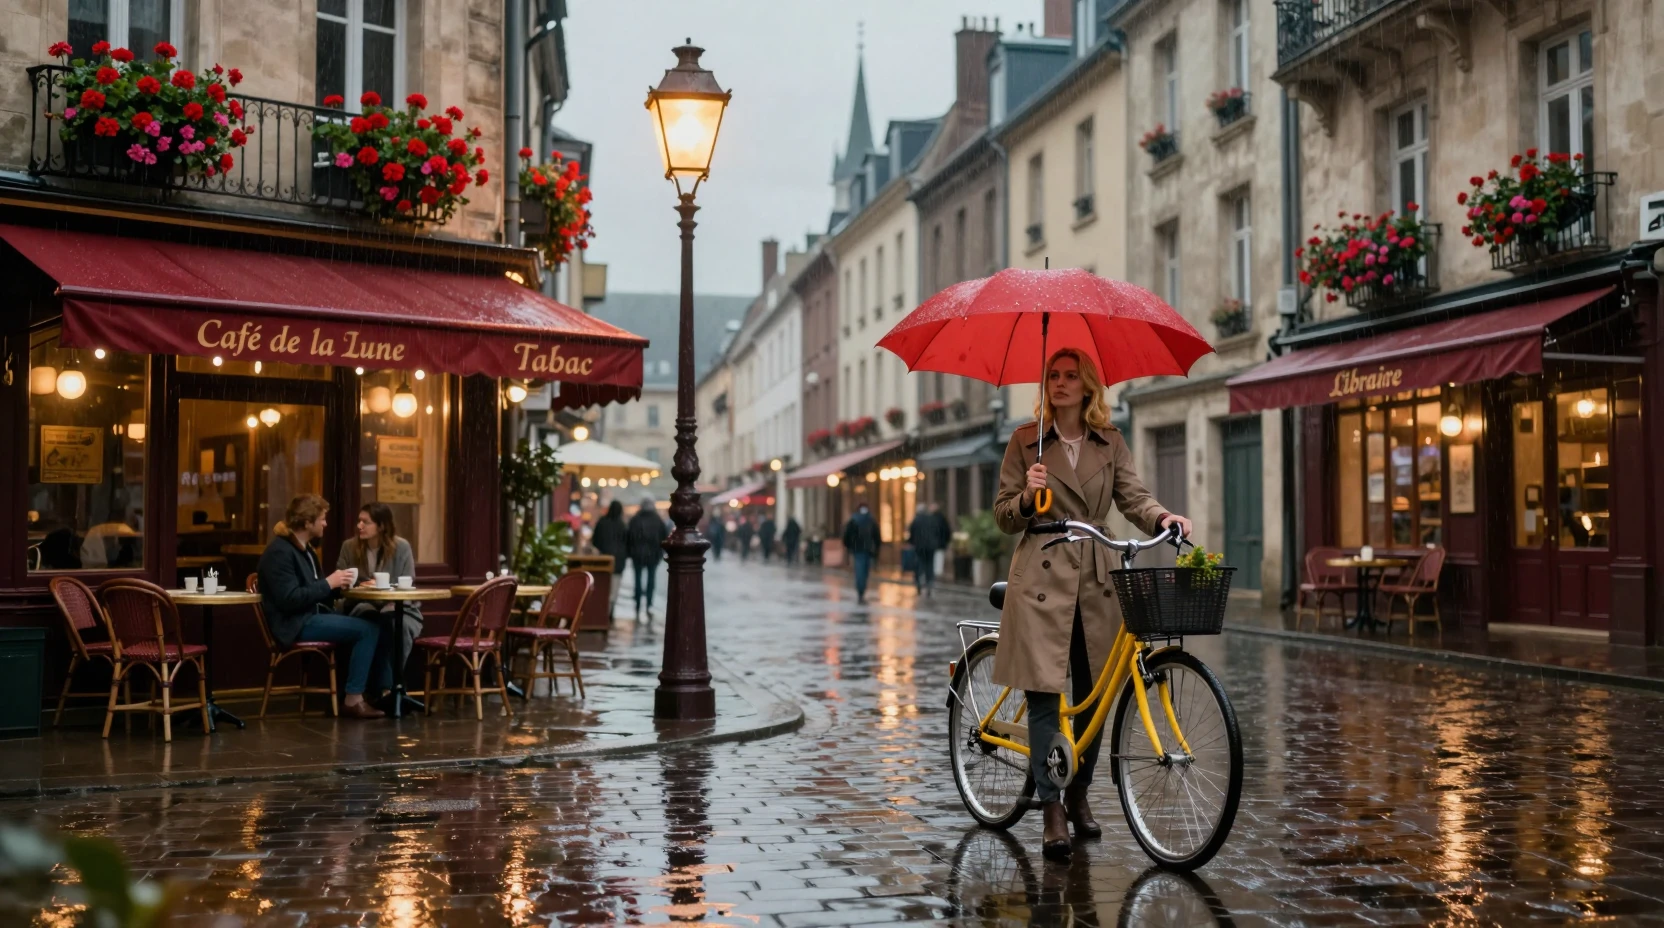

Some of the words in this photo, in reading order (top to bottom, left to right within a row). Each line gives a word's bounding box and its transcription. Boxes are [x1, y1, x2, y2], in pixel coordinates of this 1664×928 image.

[197, 319, 263, 357] Café
[269, 325, 301, 354] de
[310, 327, 335, 357] la
[513, 343, 593, 375] Tabac
[1328, 365, 1403, 398] Libraire
